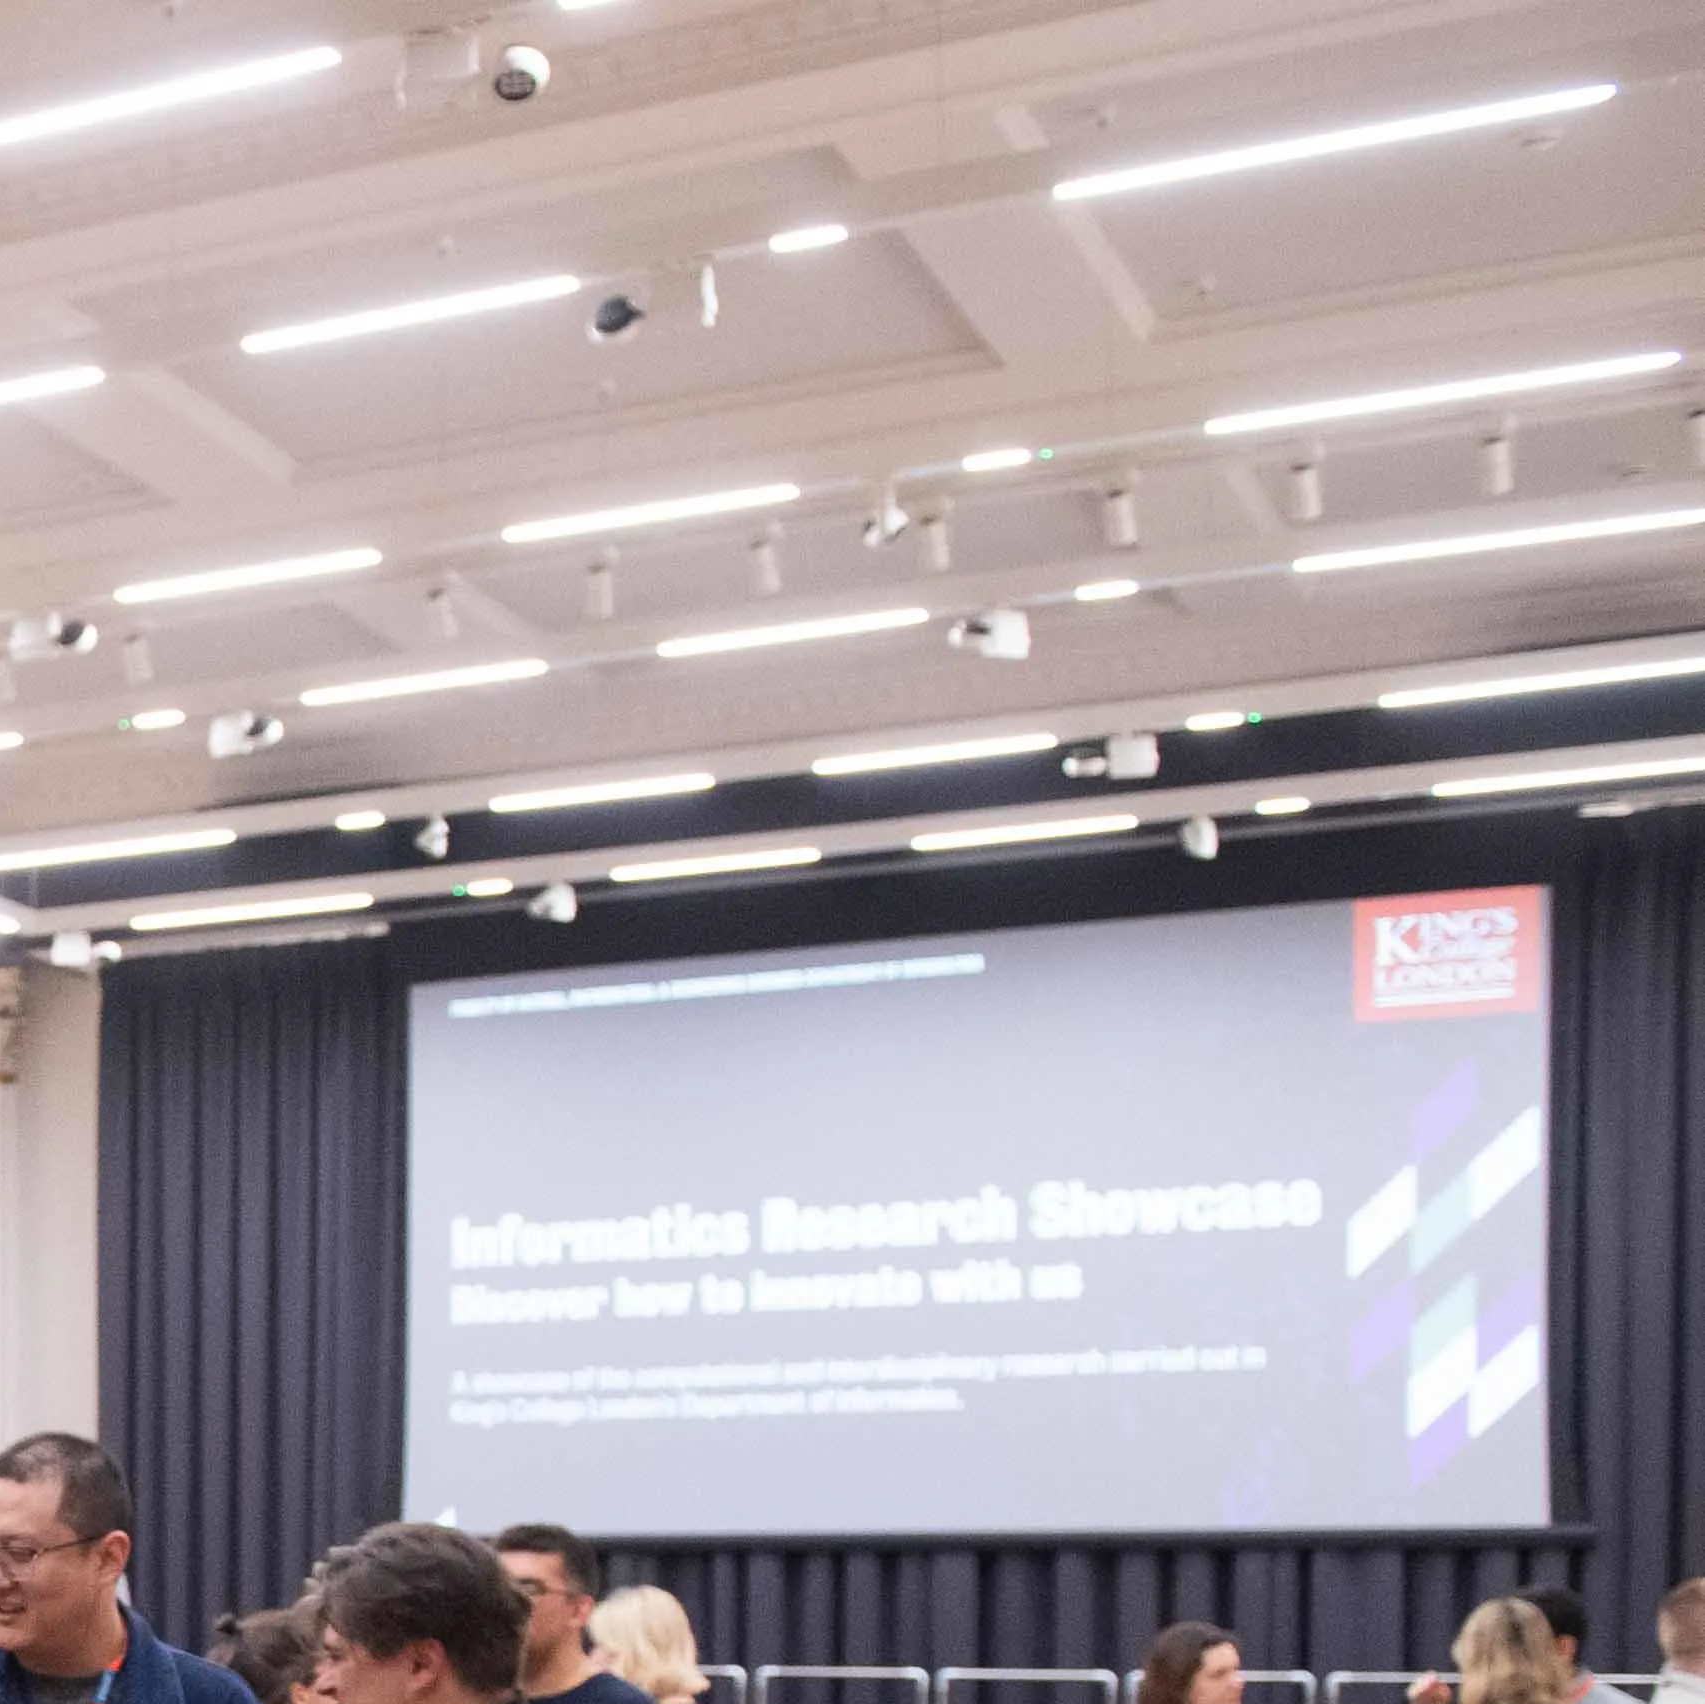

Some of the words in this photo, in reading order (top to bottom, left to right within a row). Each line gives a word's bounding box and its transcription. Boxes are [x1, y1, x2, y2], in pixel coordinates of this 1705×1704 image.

[450, 1203, 750, 1270] Informatics
[761, 1185, 1017, 1254] Research
[1029, 1178, 1322, 1240] Showcase
[450, 1284, 608, 1325] Discover
[614, 1276, 693, 1318] how
[699, 1273, 744, 1315] to
[750, 1265, 922, 1312] innovate
[929, 1257, 1022, 1304] with
[1029, 1262, 1084, 1300] us
